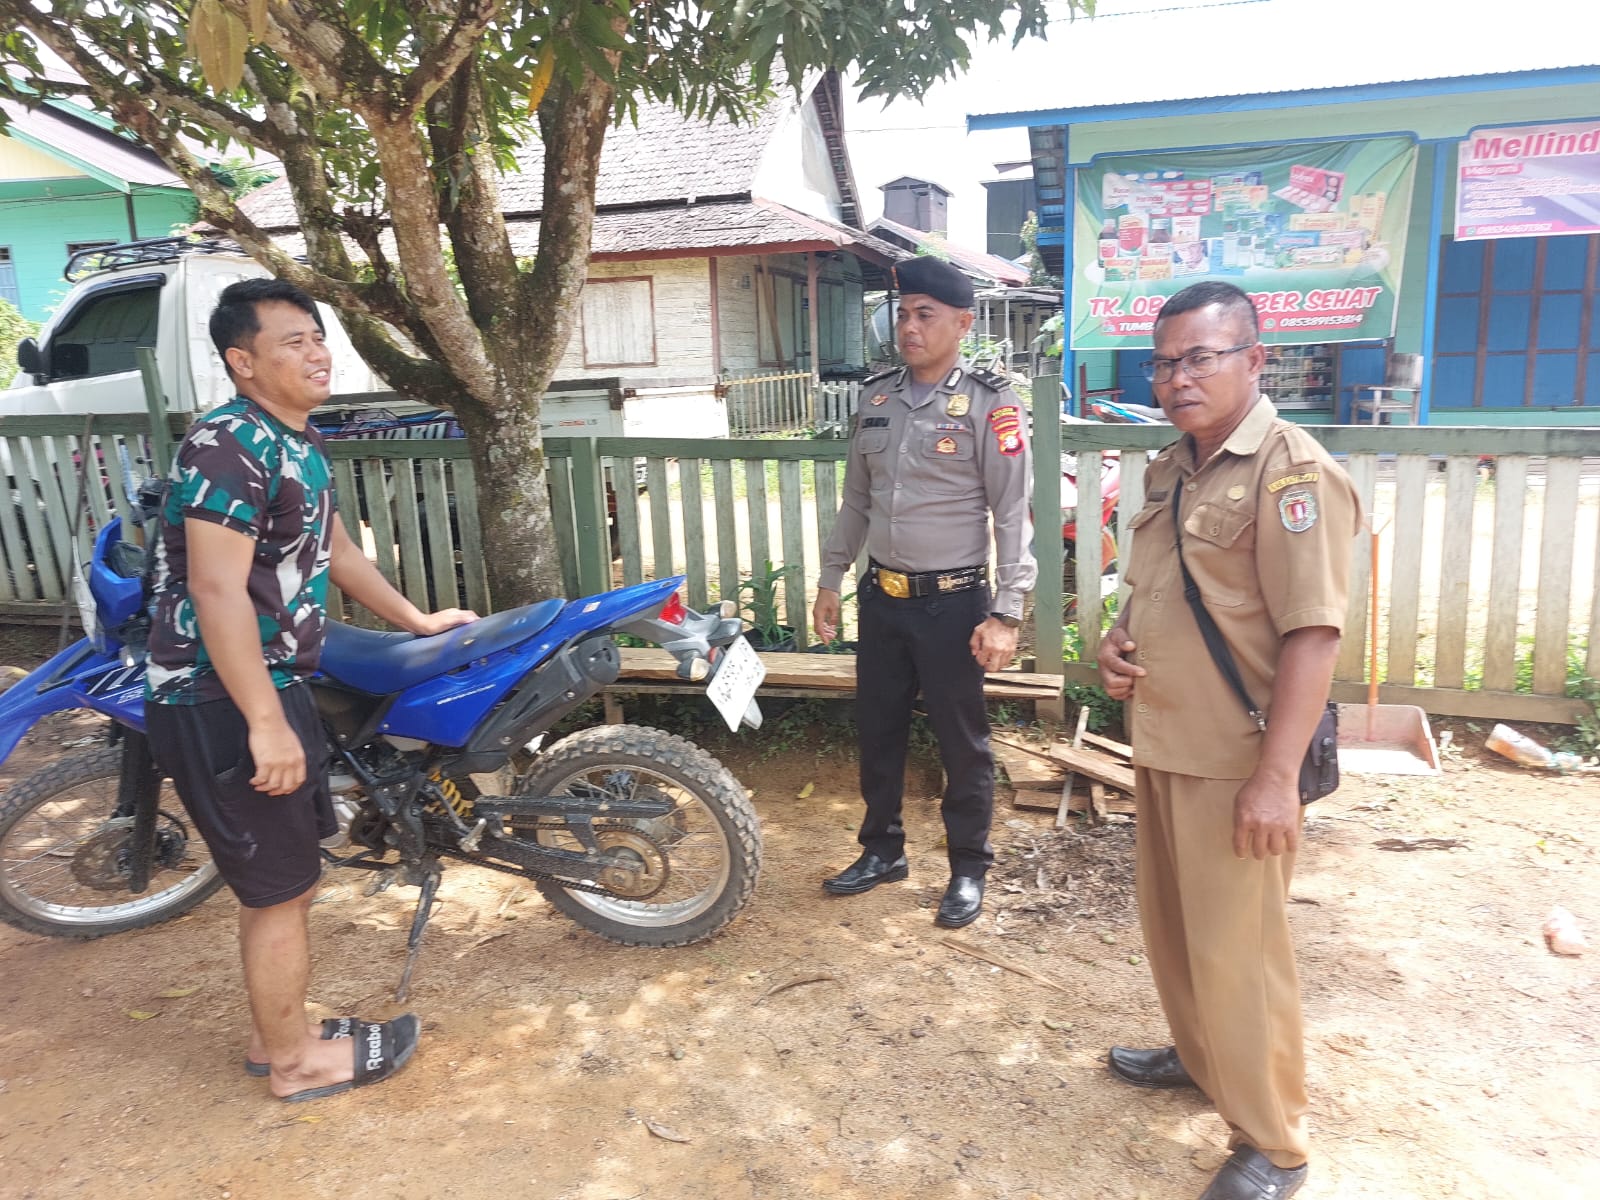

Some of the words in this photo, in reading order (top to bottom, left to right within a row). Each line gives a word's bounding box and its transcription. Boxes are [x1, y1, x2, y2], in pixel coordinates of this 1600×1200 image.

[1089, 297, 1123, 315] TK.
[1132, 296, 1167, 314] OB
[1305, 287, 1380, 310] SEHAT
[1119, 322, 1155, 331] TUMB
